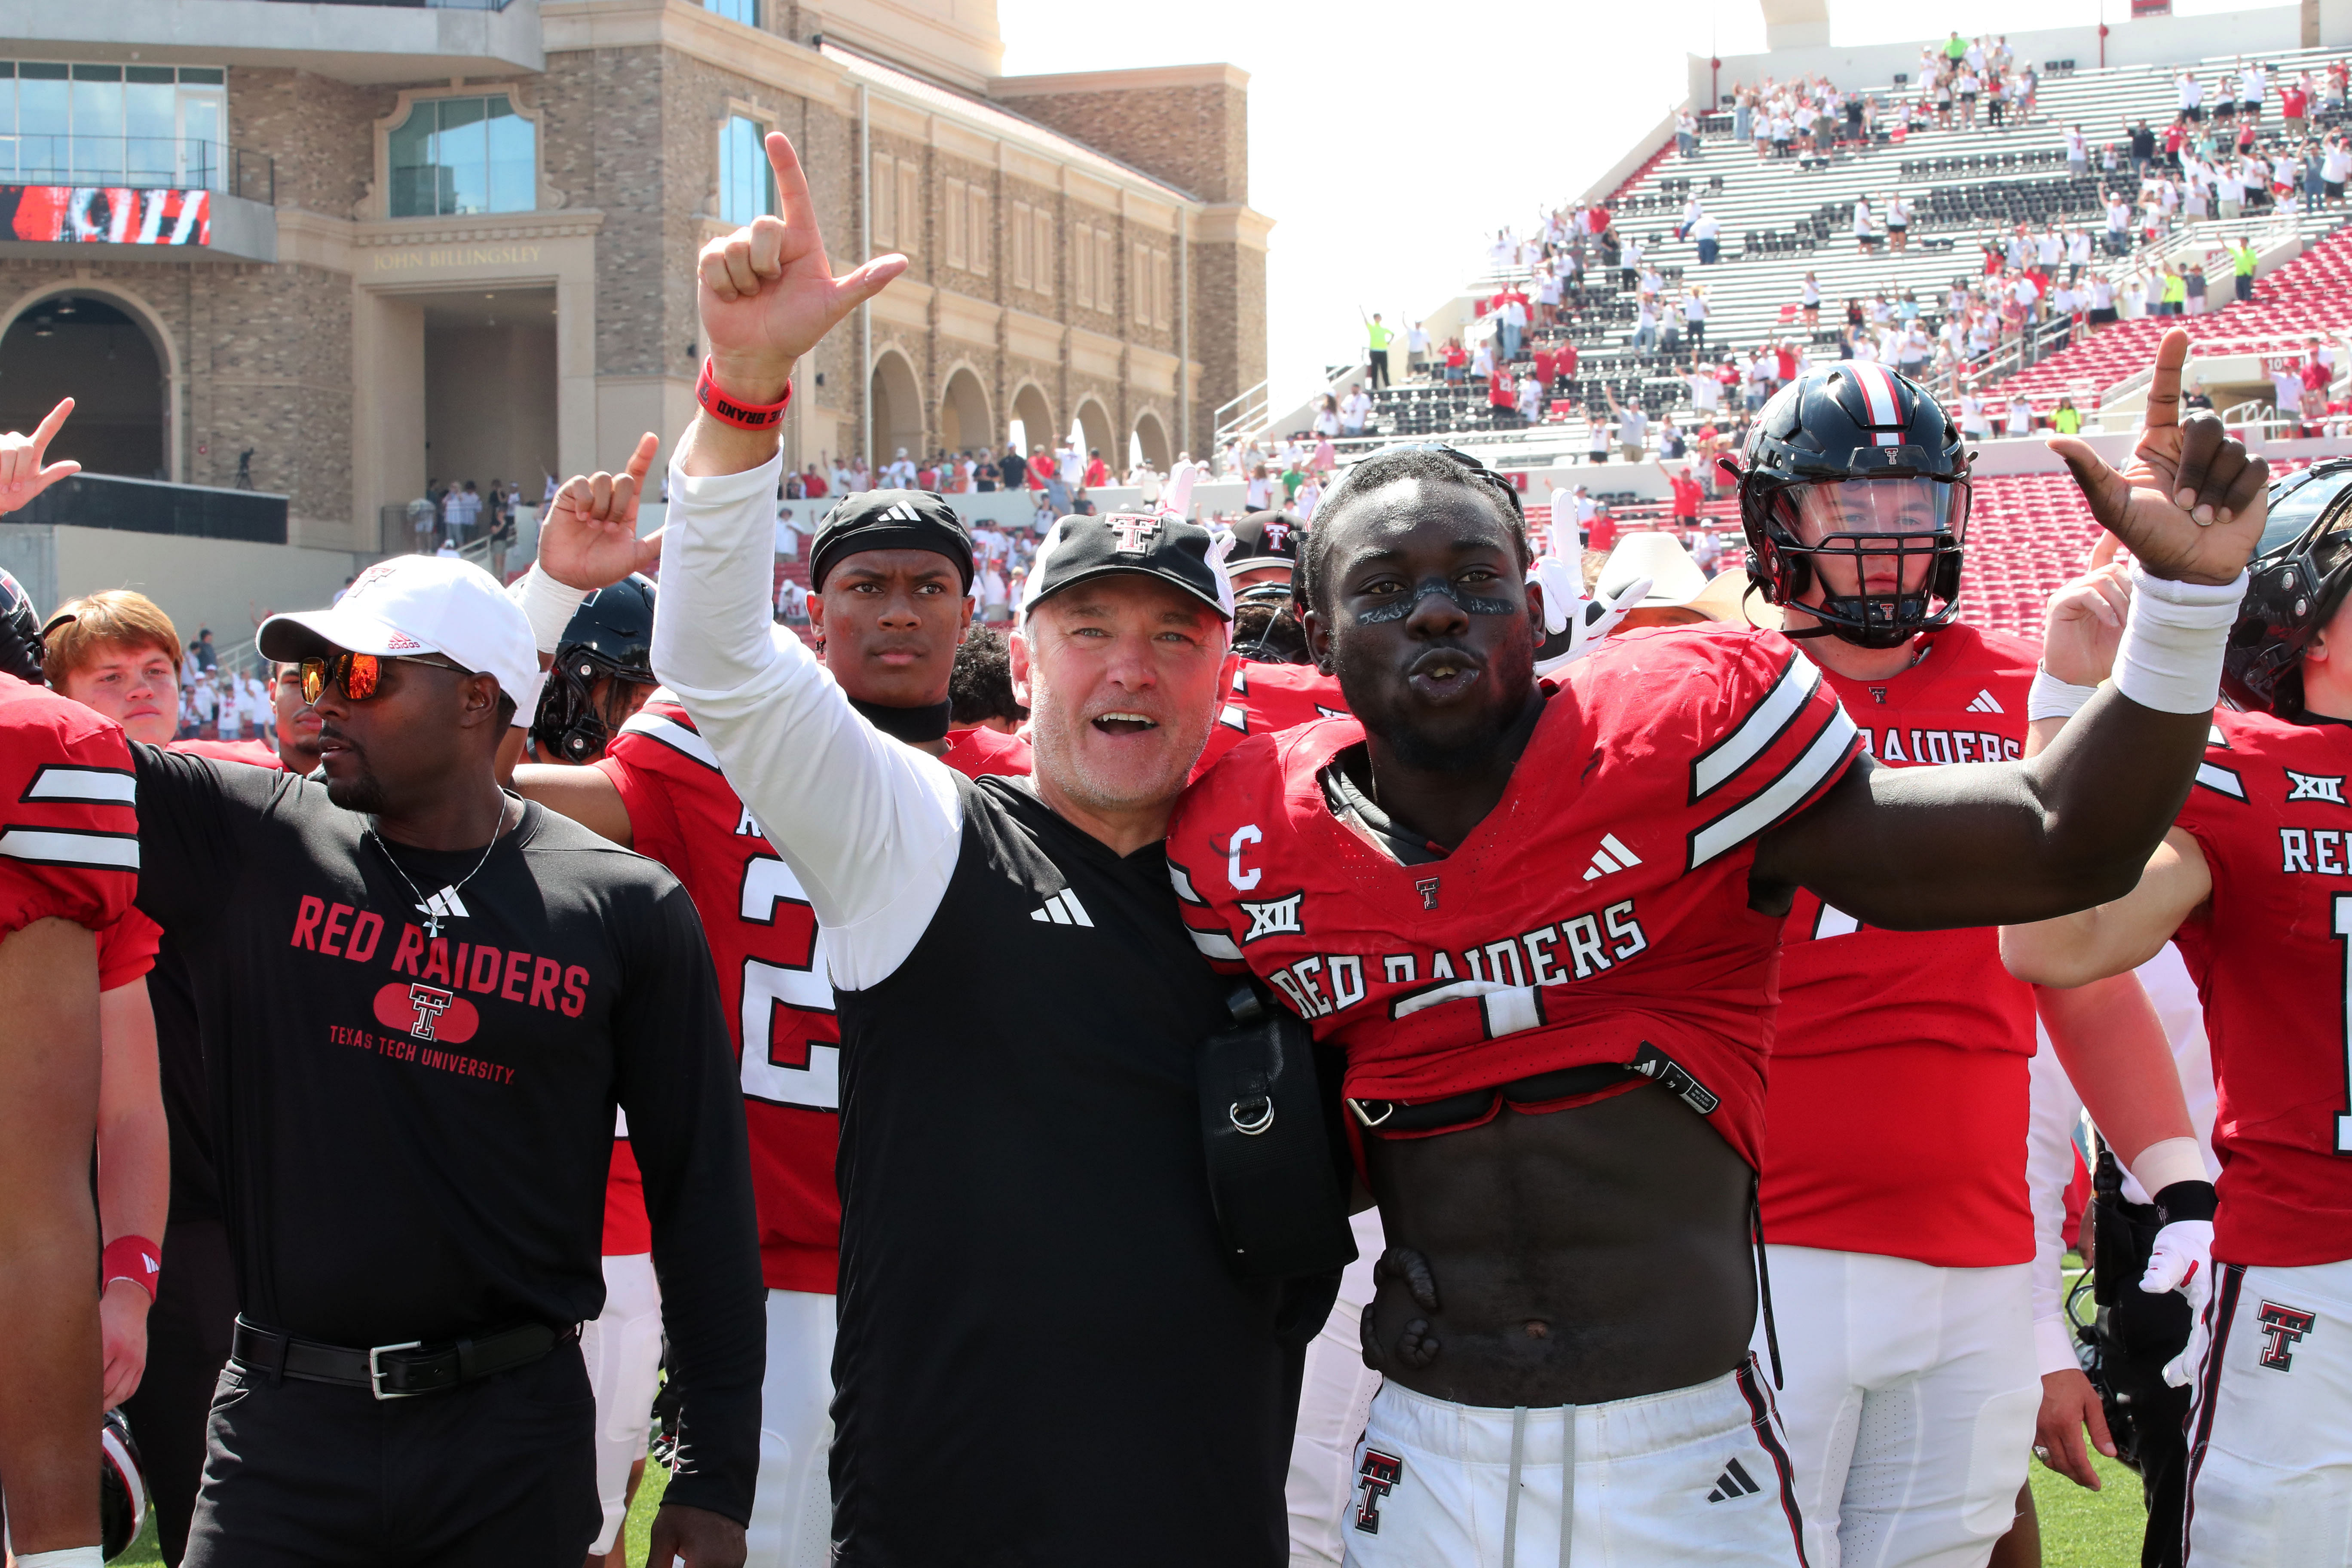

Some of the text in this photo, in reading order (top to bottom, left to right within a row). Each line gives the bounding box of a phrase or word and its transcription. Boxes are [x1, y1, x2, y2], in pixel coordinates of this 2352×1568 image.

[375, 246, 541, 271] JOHN BILLINGSLEY
[717, 399, 766, 424] BRAND
[2287, 771, 2345, 804] XII
[1228, 824, 1263, 891] C
[1240, 894, 1302, 942] XII
[291, 894, 590, 1018] RED RAIDERS
[1269, 955, 1366, 1019] RED
[330, 1025, 515, 1085] TEXAS TECH UNIVERSITY
